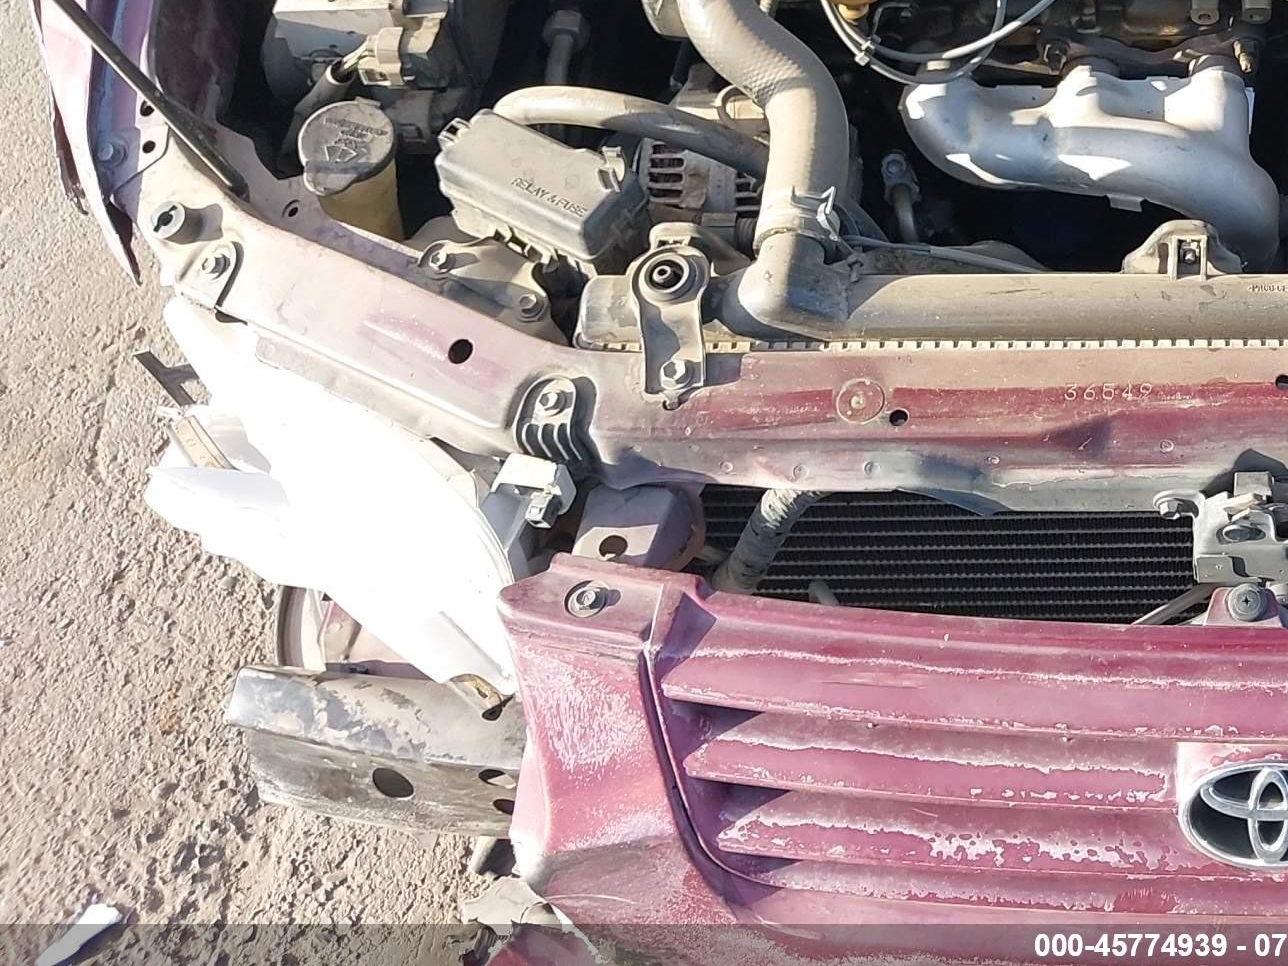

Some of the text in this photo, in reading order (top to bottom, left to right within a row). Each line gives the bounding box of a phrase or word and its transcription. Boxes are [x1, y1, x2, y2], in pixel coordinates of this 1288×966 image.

[511, 177, 550, 199] RELAY
[556, 198, 588, 217] FUSE
[1064, 383, 1152, 400] 36549
